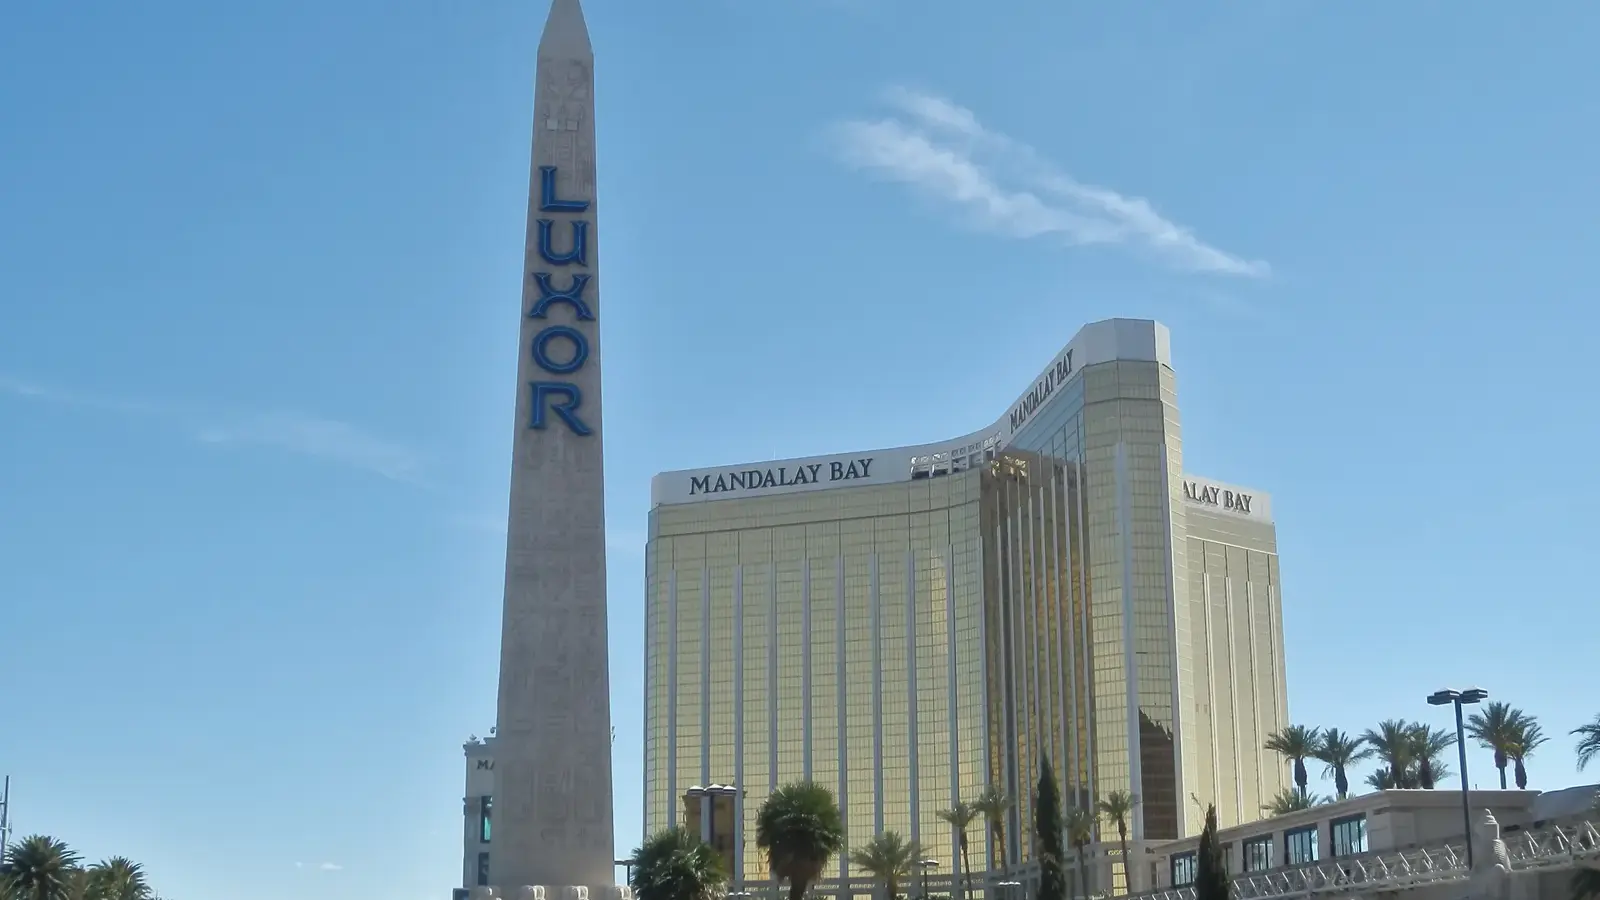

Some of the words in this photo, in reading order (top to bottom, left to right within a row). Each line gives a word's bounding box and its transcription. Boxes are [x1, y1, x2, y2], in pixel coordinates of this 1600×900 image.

[527, 165, 596, 436] LUXOR
[1010, 368, 1055, 434] MANDALAY
[1056, 348, 1073, 386] BAY
[689, 463, 822, 495] MANDALAY
[829, 458, 873, 481] BAY
[1223, 489, 1252, 513] BAY
